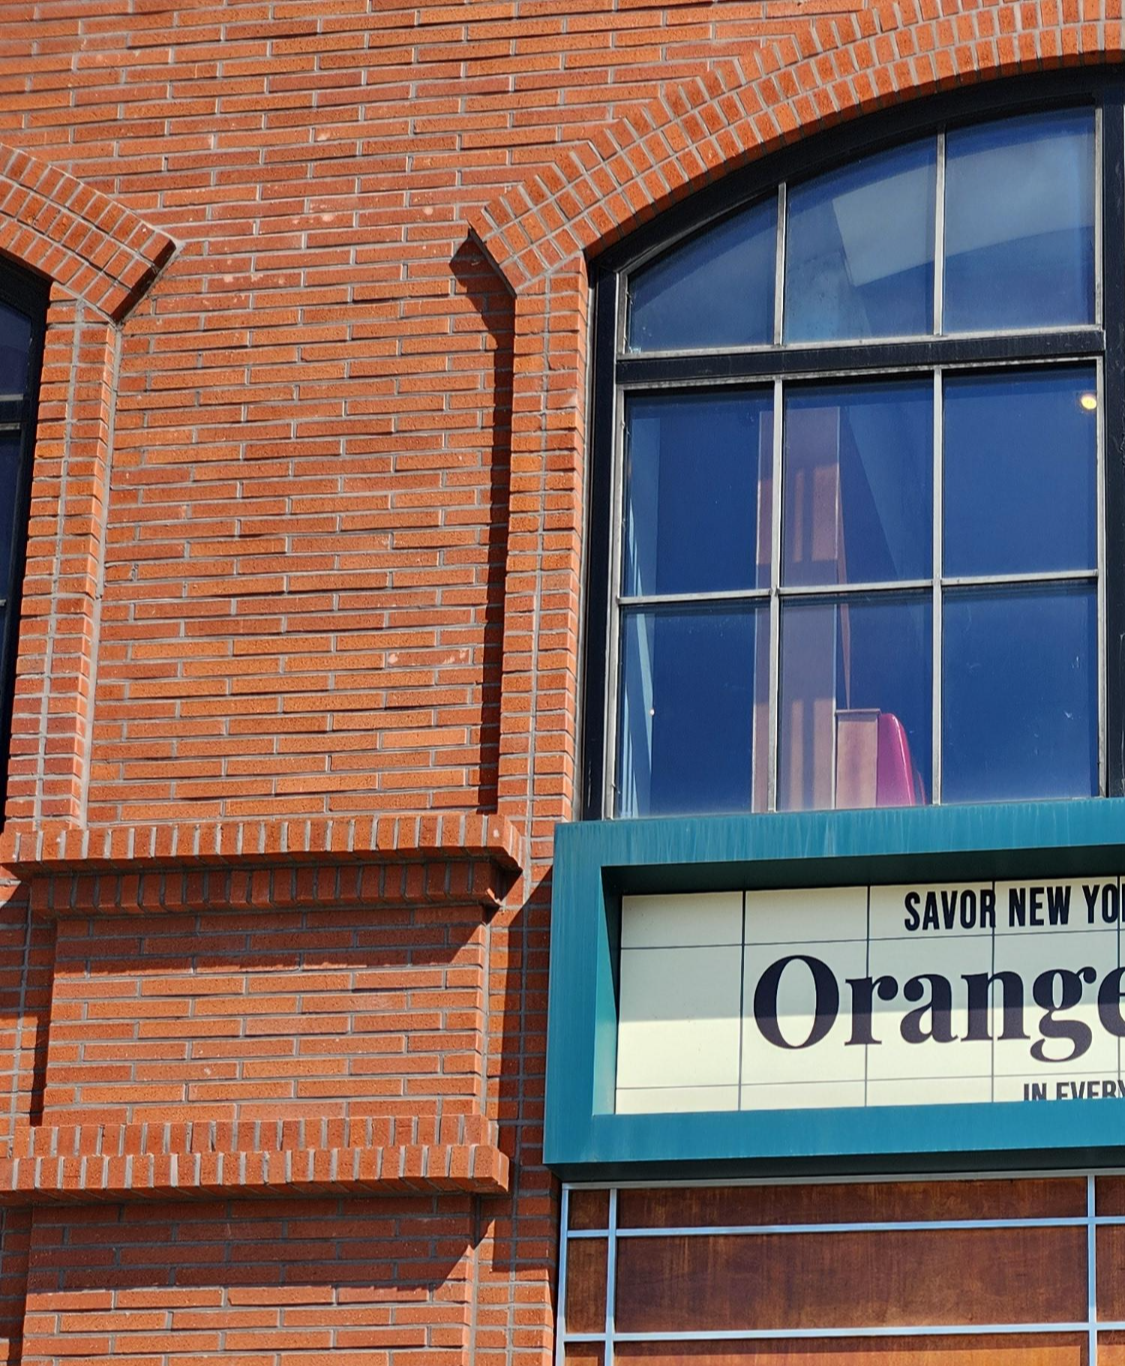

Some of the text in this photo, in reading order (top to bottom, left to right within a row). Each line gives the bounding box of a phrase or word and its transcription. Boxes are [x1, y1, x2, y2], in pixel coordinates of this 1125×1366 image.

[904, 889, 996, 931] SAVOR
[1008, 885, 1069, 927] NEW
[1023, 1083, 1047, 1101] IN
